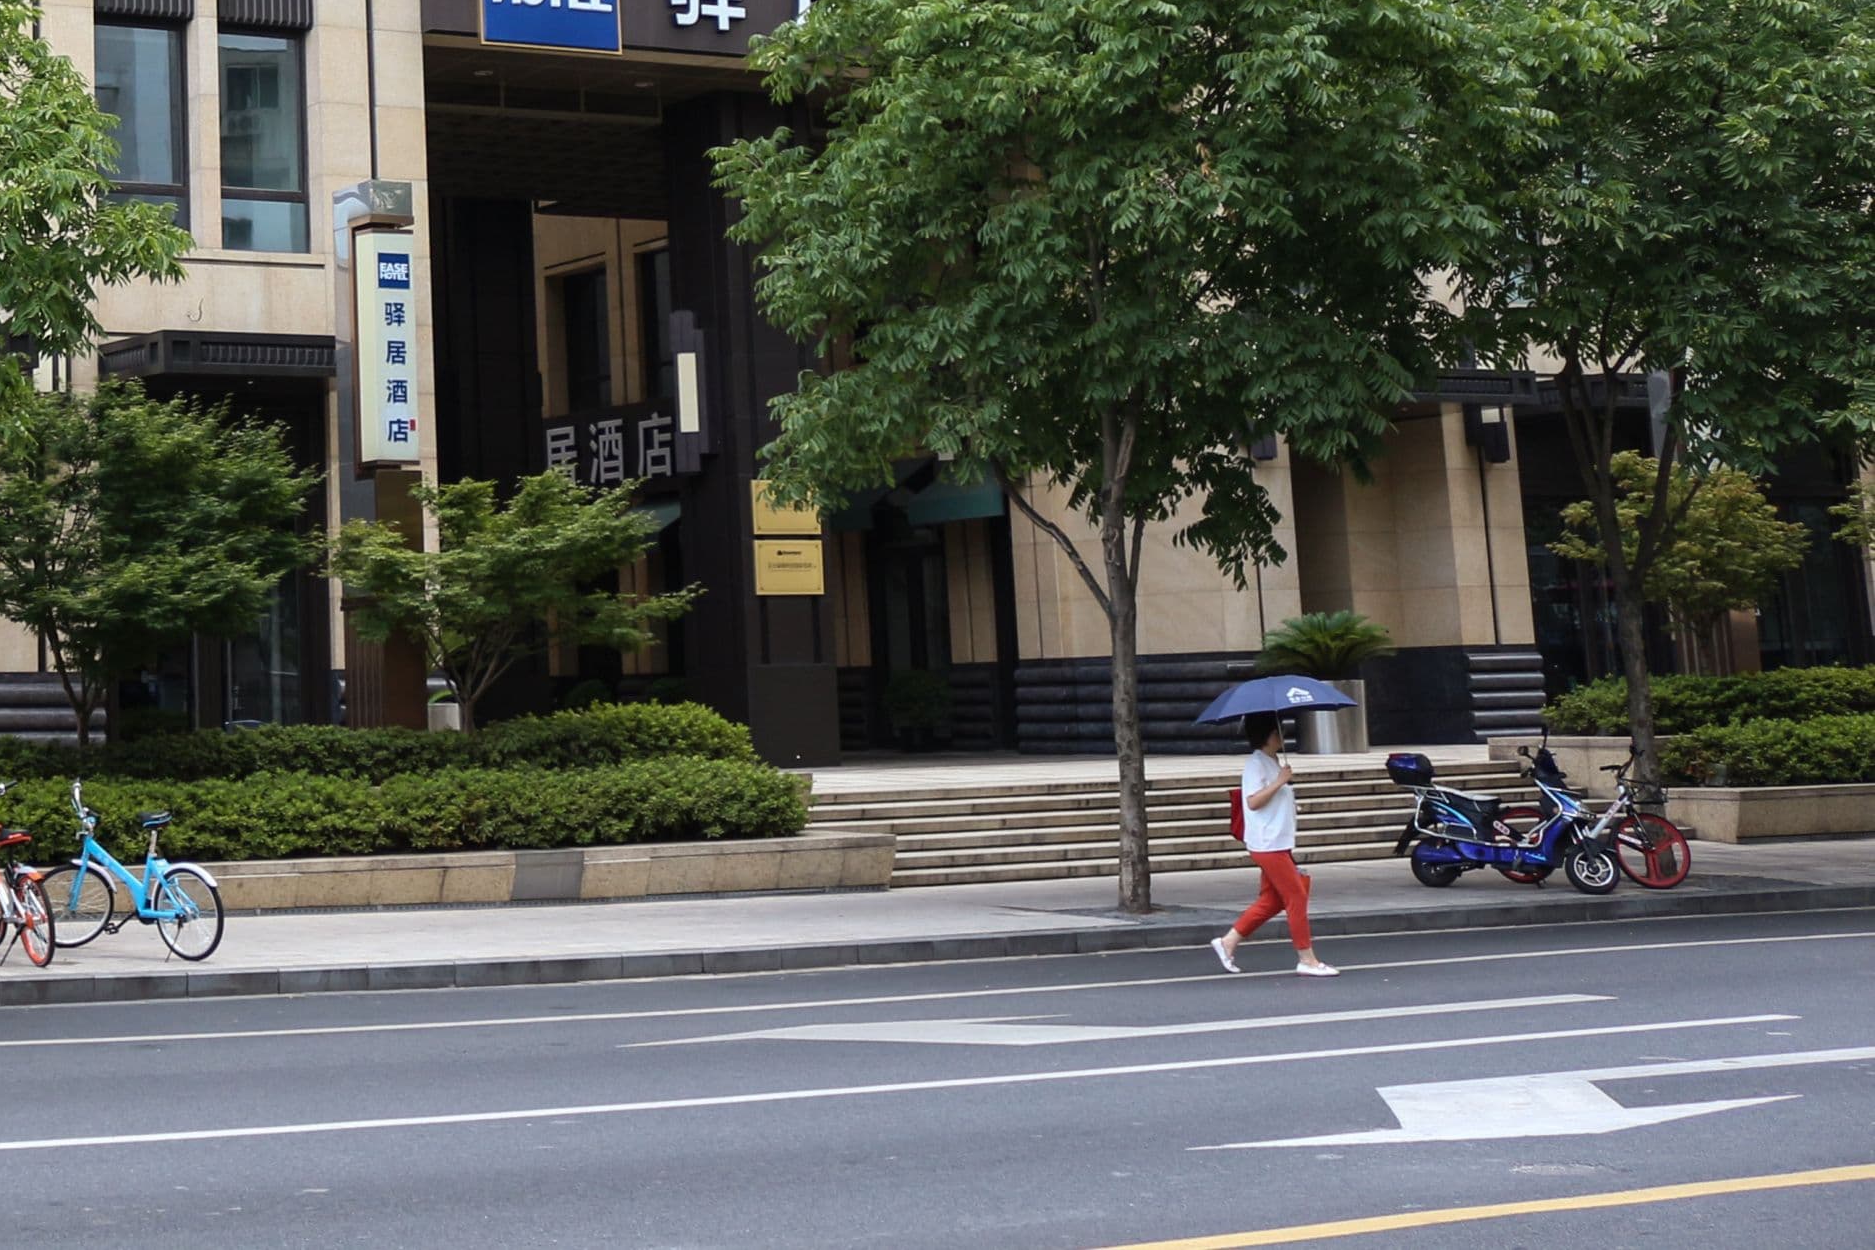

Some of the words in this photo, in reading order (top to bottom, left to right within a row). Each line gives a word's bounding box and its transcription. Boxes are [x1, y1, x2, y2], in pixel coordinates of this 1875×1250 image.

[379, 261, 409, 274] EASE
[380, 271, 409, 281] HOTEL
[384, 302, 409, 443] 驿居酒店
[546, 412, 672, 485] 居酒店
